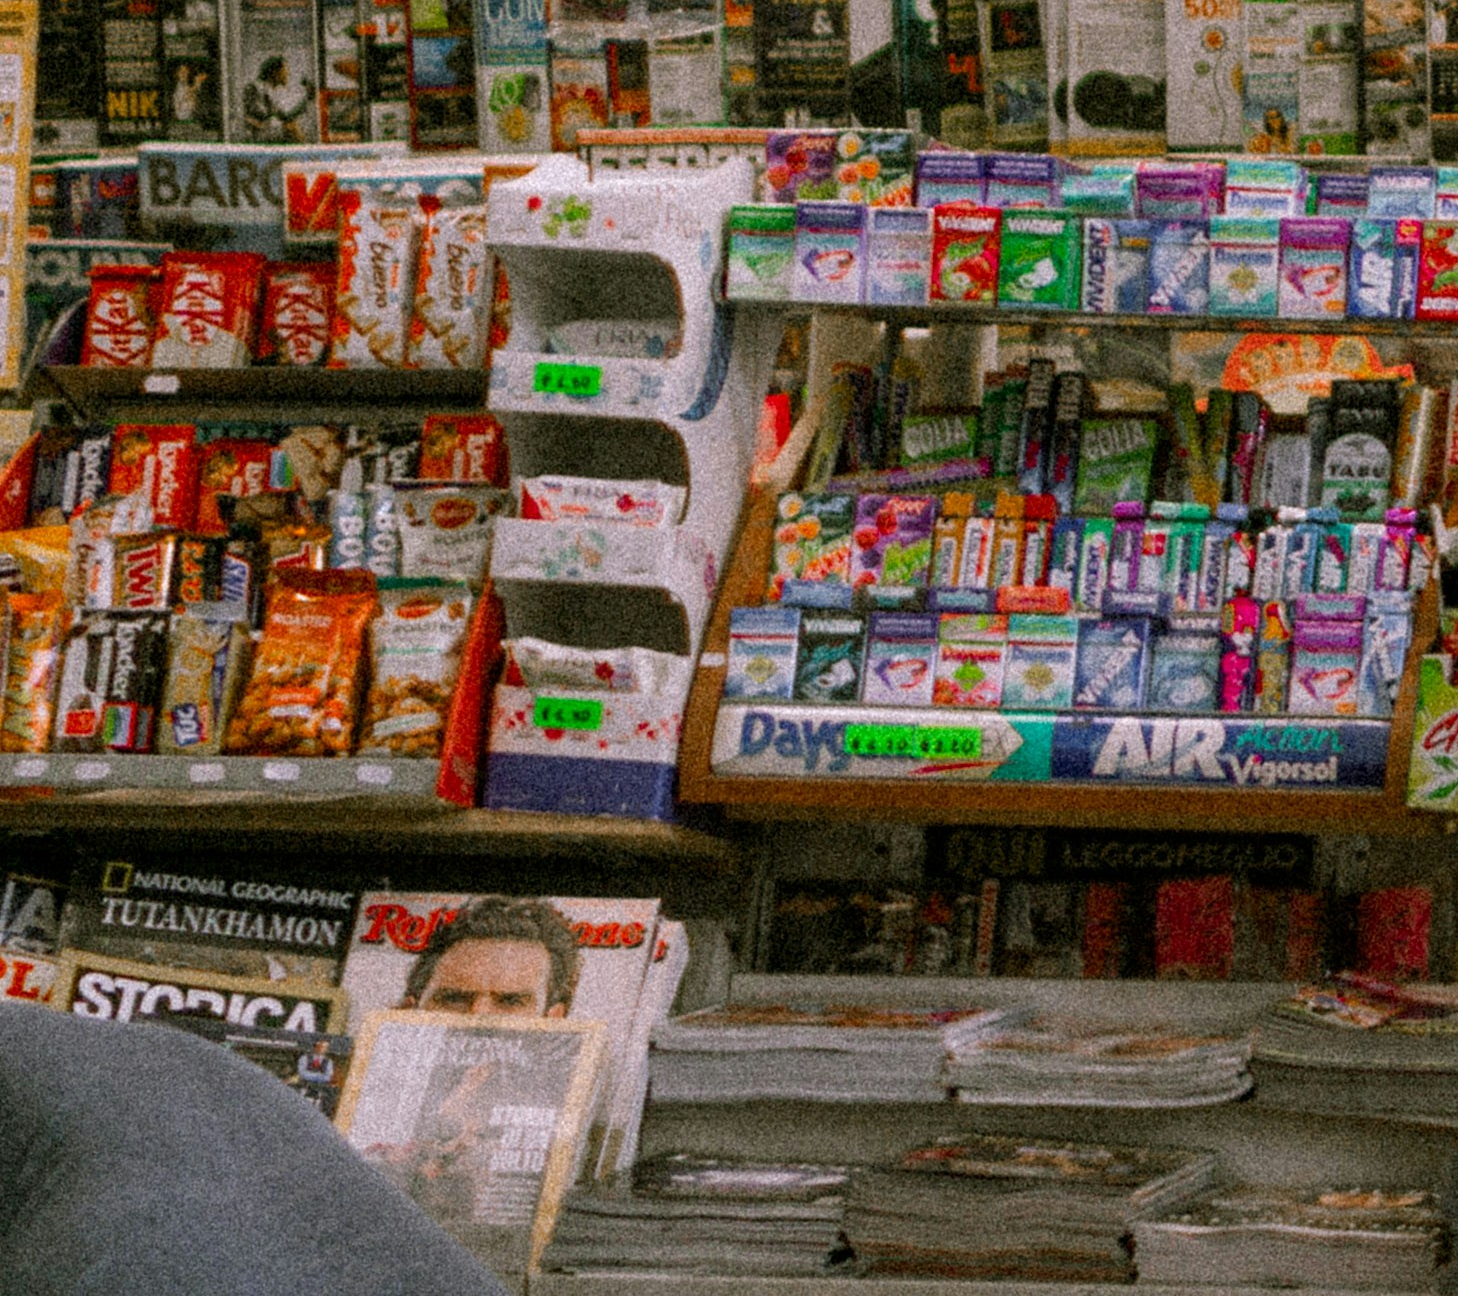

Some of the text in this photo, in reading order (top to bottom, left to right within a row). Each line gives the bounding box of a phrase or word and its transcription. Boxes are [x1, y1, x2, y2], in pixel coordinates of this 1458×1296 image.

[125, 542, 163, 608] TWI
[1091, 718, 1228, 780] AIR
[1235, 721, 1344, 754] Action
[1228, 754, 1339, 787] Vigorsol
[132, 871, 352, 908] NATIONAL GEOGRAPHIC
[100, 897, 342, 947] TUTANKHAMON
